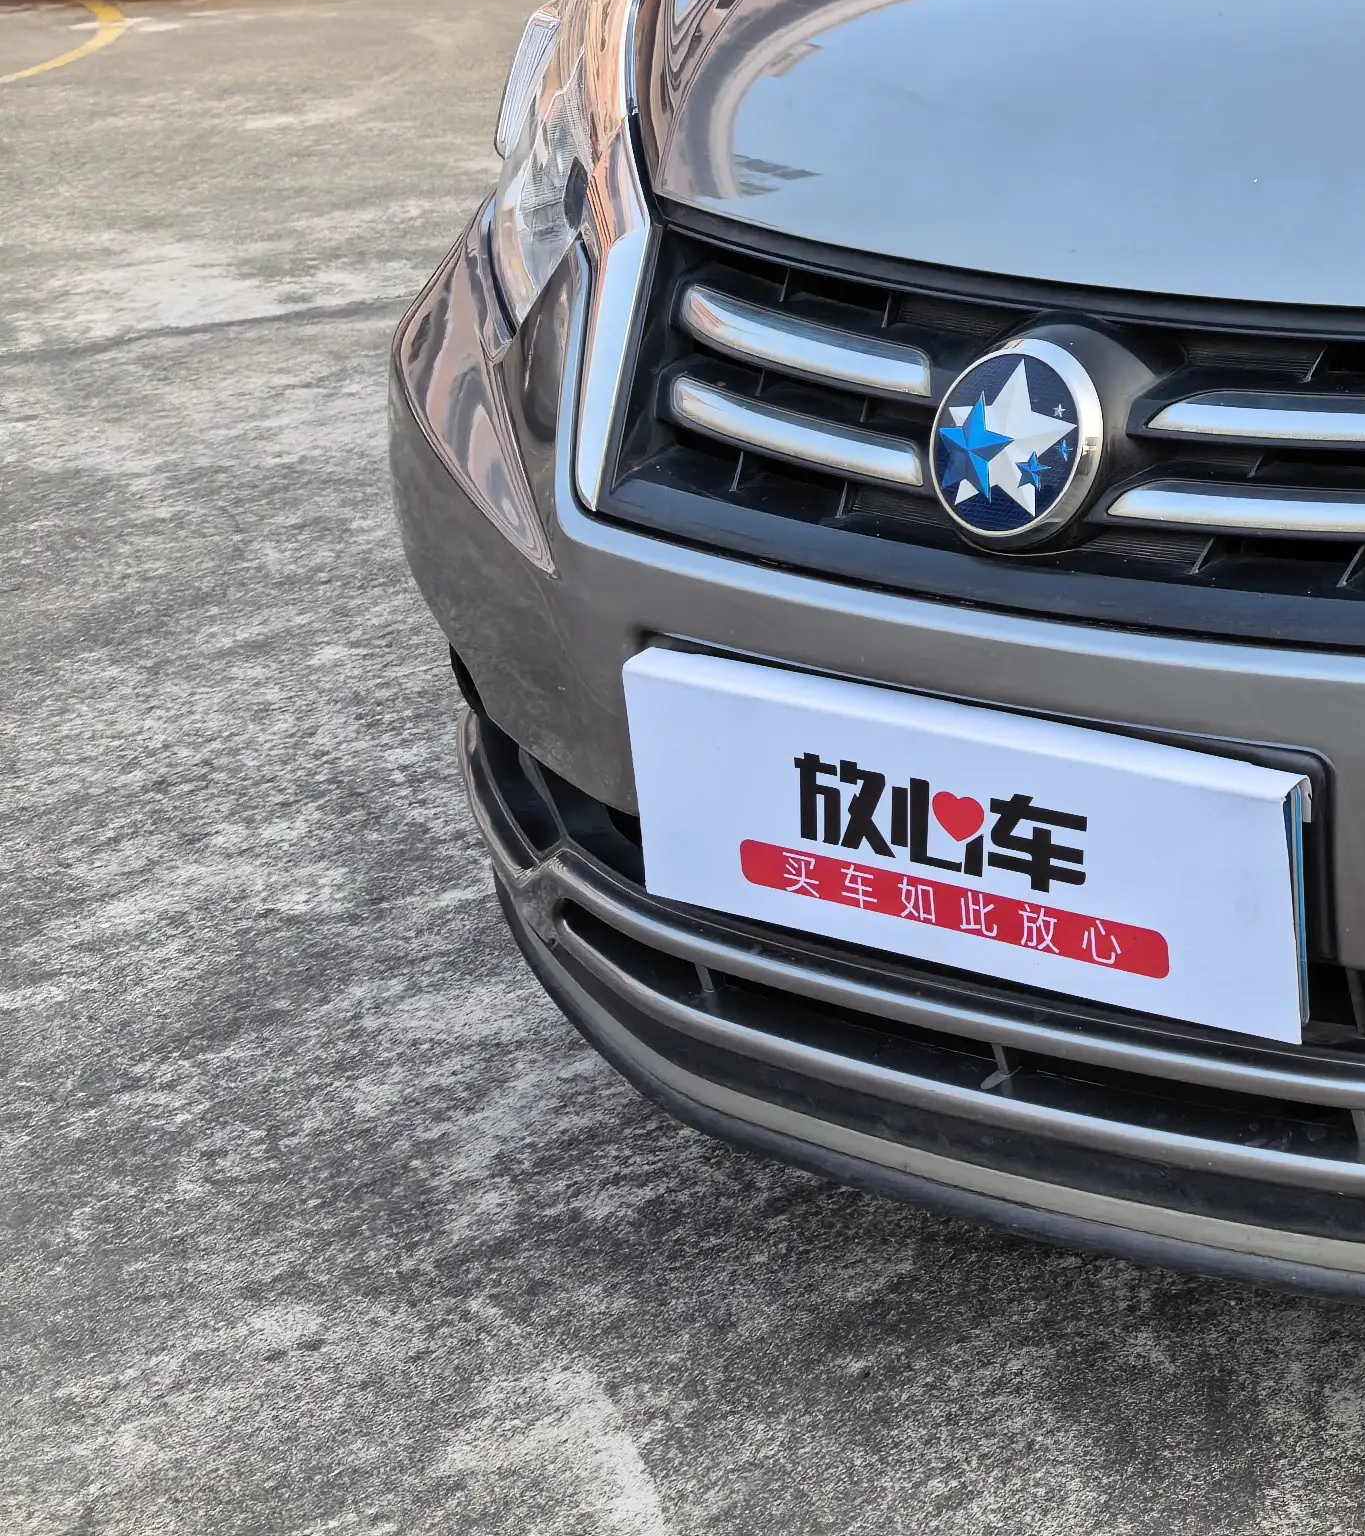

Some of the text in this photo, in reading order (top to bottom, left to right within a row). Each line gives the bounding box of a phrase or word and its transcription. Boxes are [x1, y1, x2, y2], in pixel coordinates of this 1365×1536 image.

[794, 752, 1088, 893] 放心车
[782, 850, 1122, 965] 买车如此放心
